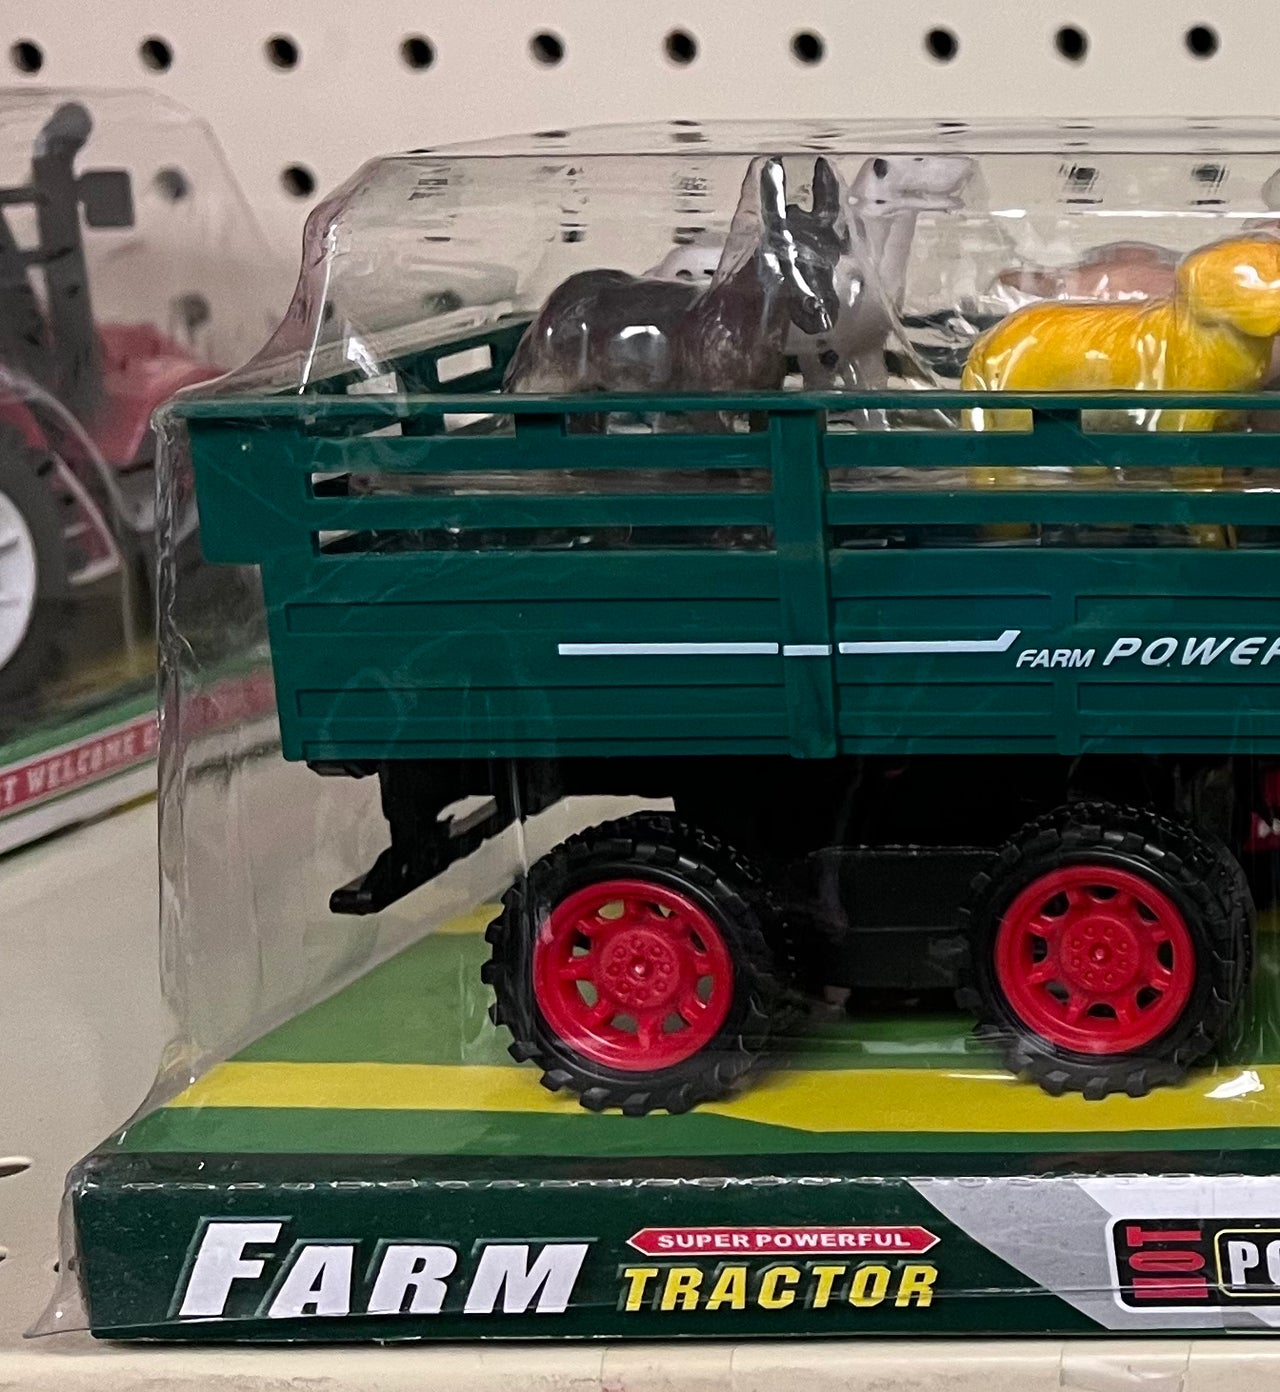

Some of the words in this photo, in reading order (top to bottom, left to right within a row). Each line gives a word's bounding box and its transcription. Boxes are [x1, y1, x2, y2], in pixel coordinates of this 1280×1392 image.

[1016, 649, 1096, 668] FARM
[657, 1230, 749, 1248] SUPER
[755, 1230, 911, 1249] POWERFUL
[178, 1221, 590, 1318] FARM
[624, 1265, 938, 1312] TRACTOR
